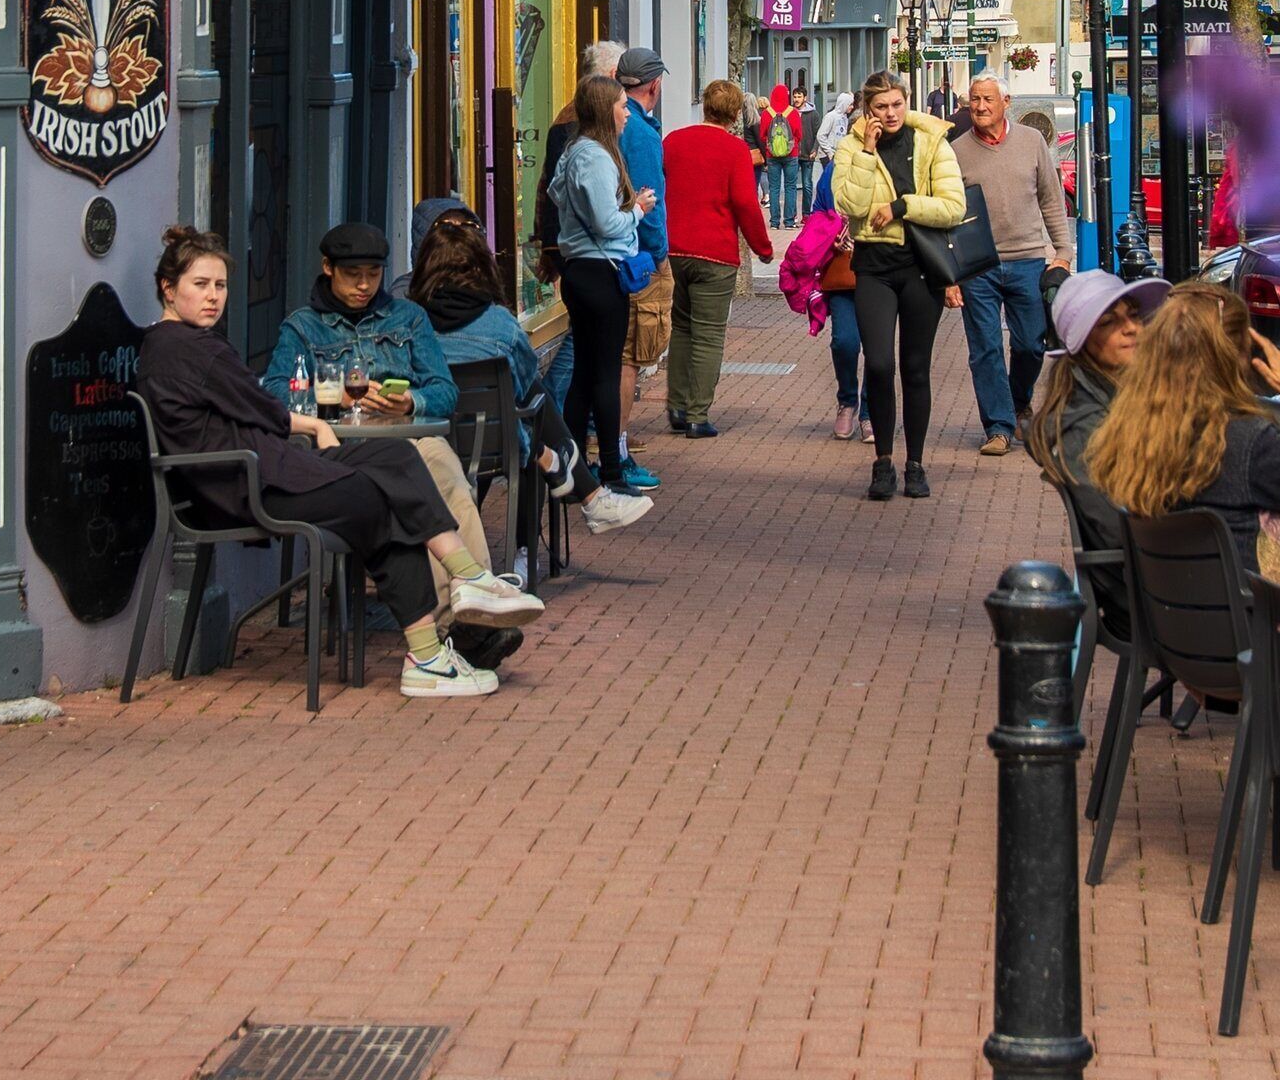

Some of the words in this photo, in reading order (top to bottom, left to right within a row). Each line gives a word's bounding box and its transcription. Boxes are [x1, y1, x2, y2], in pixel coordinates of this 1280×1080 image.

[770, 14, 793, 25] AIB
[29, 99, 100, 157] IRISH
[101, 91, 168, 157] STOUT
[51, 353, 90, 378] Irish
[98, 345, 140, 383] Coffe
[75, 379, 125, 406] Lattes
